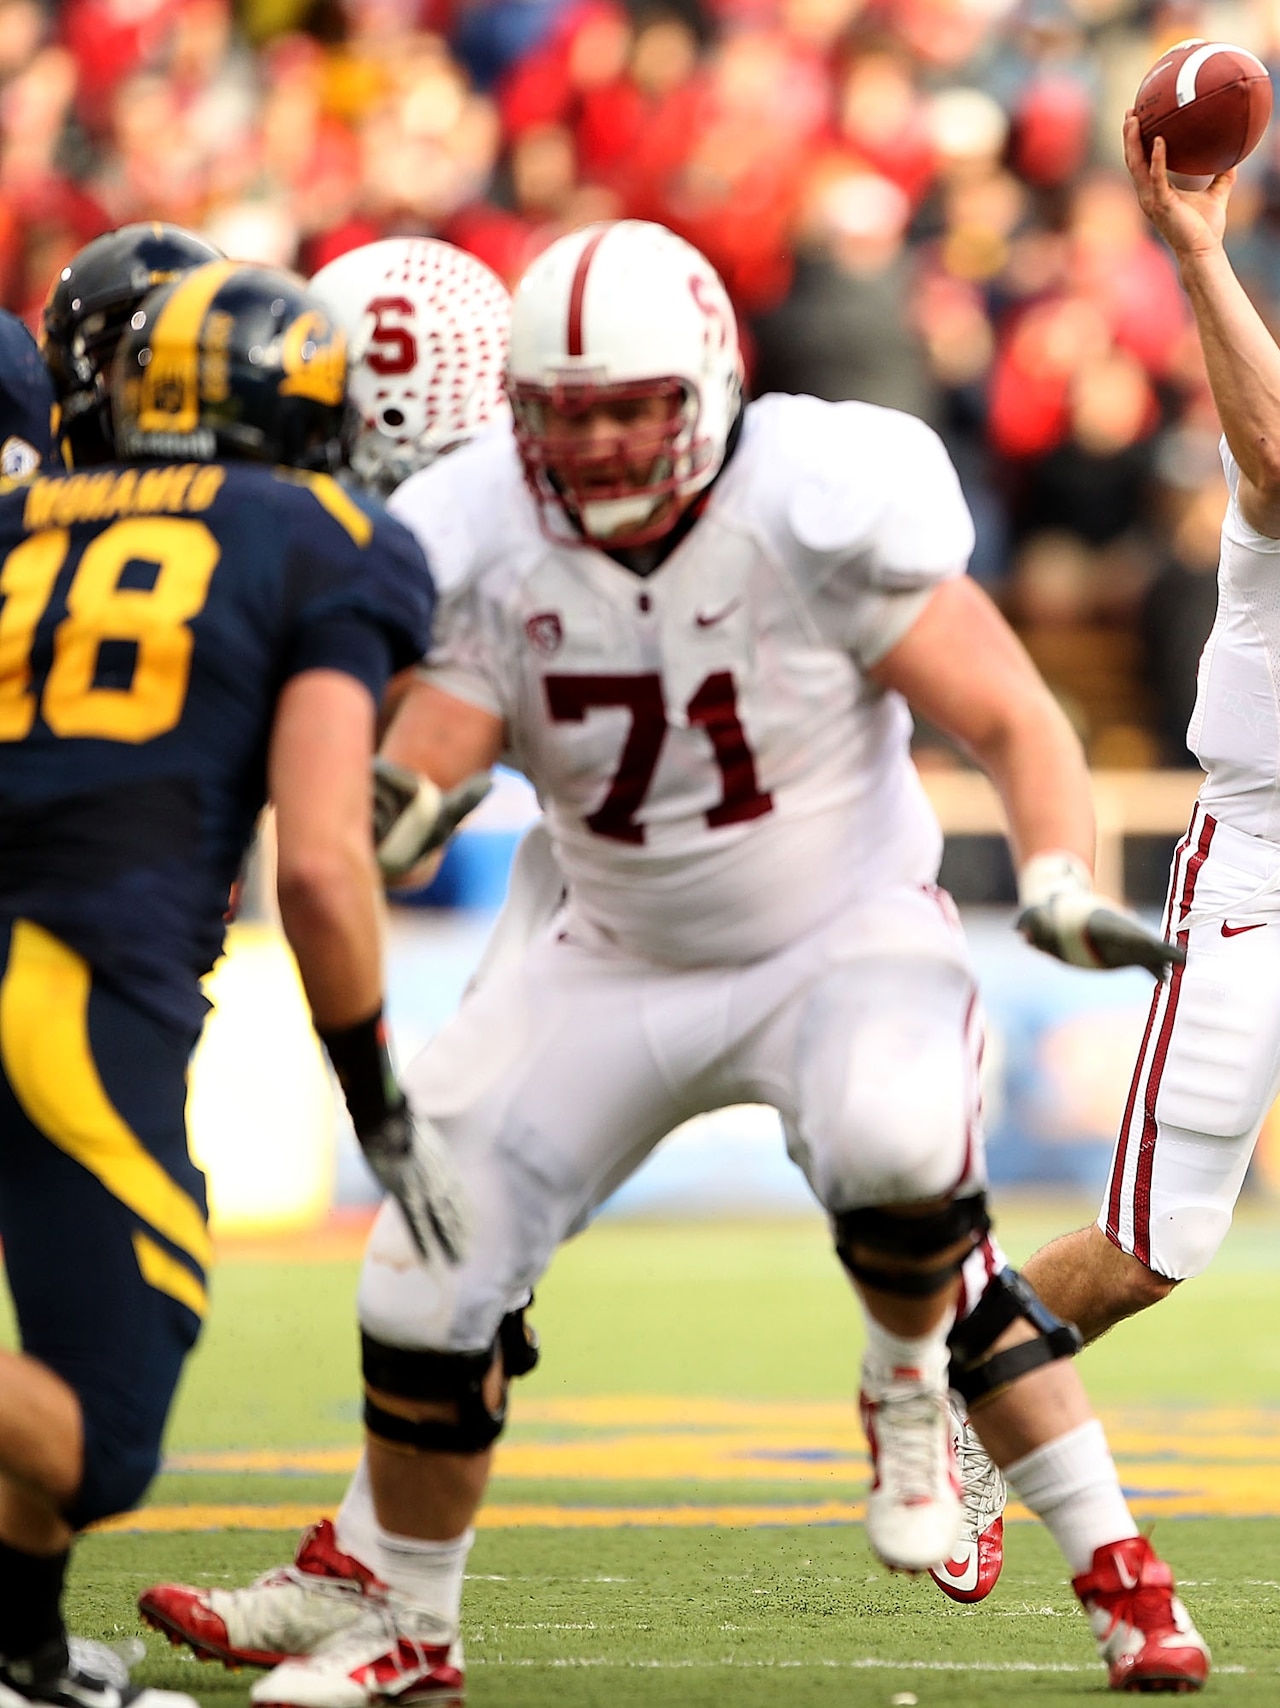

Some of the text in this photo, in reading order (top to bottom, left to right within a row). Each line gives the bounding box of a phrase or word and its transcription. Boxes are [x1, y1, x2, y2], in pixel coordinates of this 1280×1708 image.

[363, 296, 418, 376] S
[0, 515, 221, 745] 18
[543, 670, 775, 846] 71
